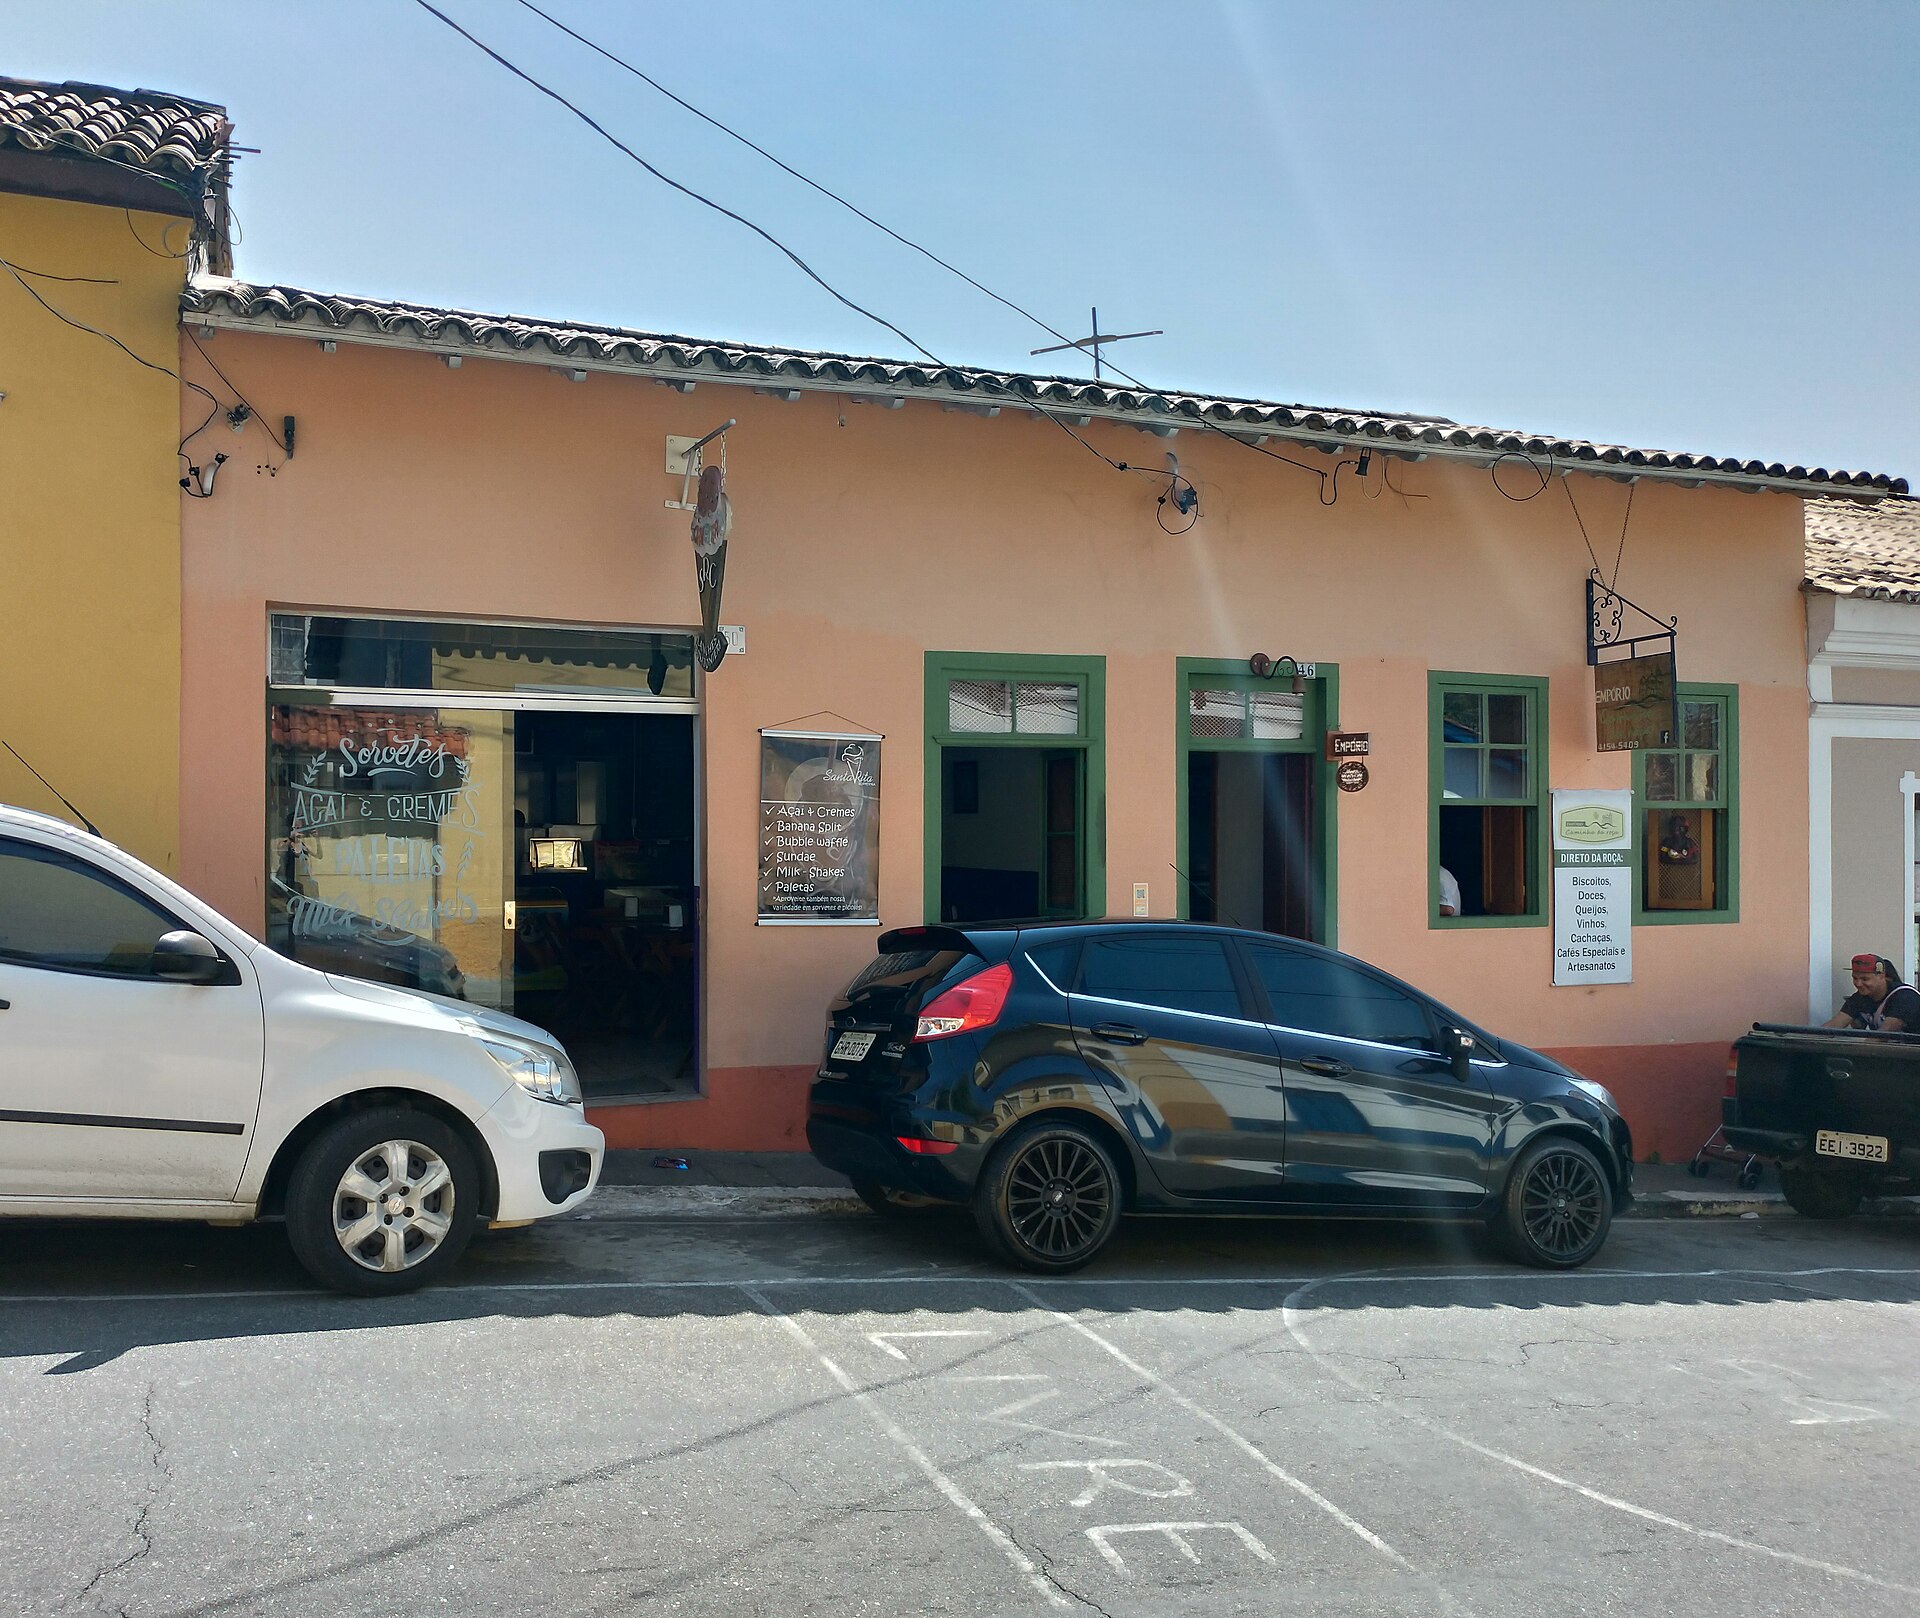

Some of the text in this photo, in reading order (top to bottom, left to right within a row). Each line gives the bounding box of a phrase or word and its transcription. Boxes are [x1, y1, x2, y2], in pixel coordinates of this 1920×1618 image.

[1298, 663, 1314, 677] 46
[339, 734, 454, 778] Sorvetes
[823, 769, 853, 782] Santa
[387, 789, 480, 828] CREMES
[817, 806, 856, 818] Cremes
[776, 820, 842, 834] Banana Split
[776, 835, 814, 847] Bubble
[335, 836, 447, 884] PALETAS
[776, 851, 816, 864] Sundae
[1560, 852, 1624, 865] DIRETO DA ROÇA:
[776, 866, 801, 878] Milk
[809, 866, 845, 879] Shakes
[775, 881, 815, 893] Paletas
[1572, 876, 1612, 887] Biscoitos,
[1578, 890, 1606, 901] Doces,
[1575, 905, 1609, 916] Queijos,
[1576, 919, 1607, 929] Vinhos,
[1570, 933, 1613, 944] Cachaças,
[1557, 946, 1626, 958] Cafés Especiais e
[1567, 962, 1616, 972] Artesanatos
